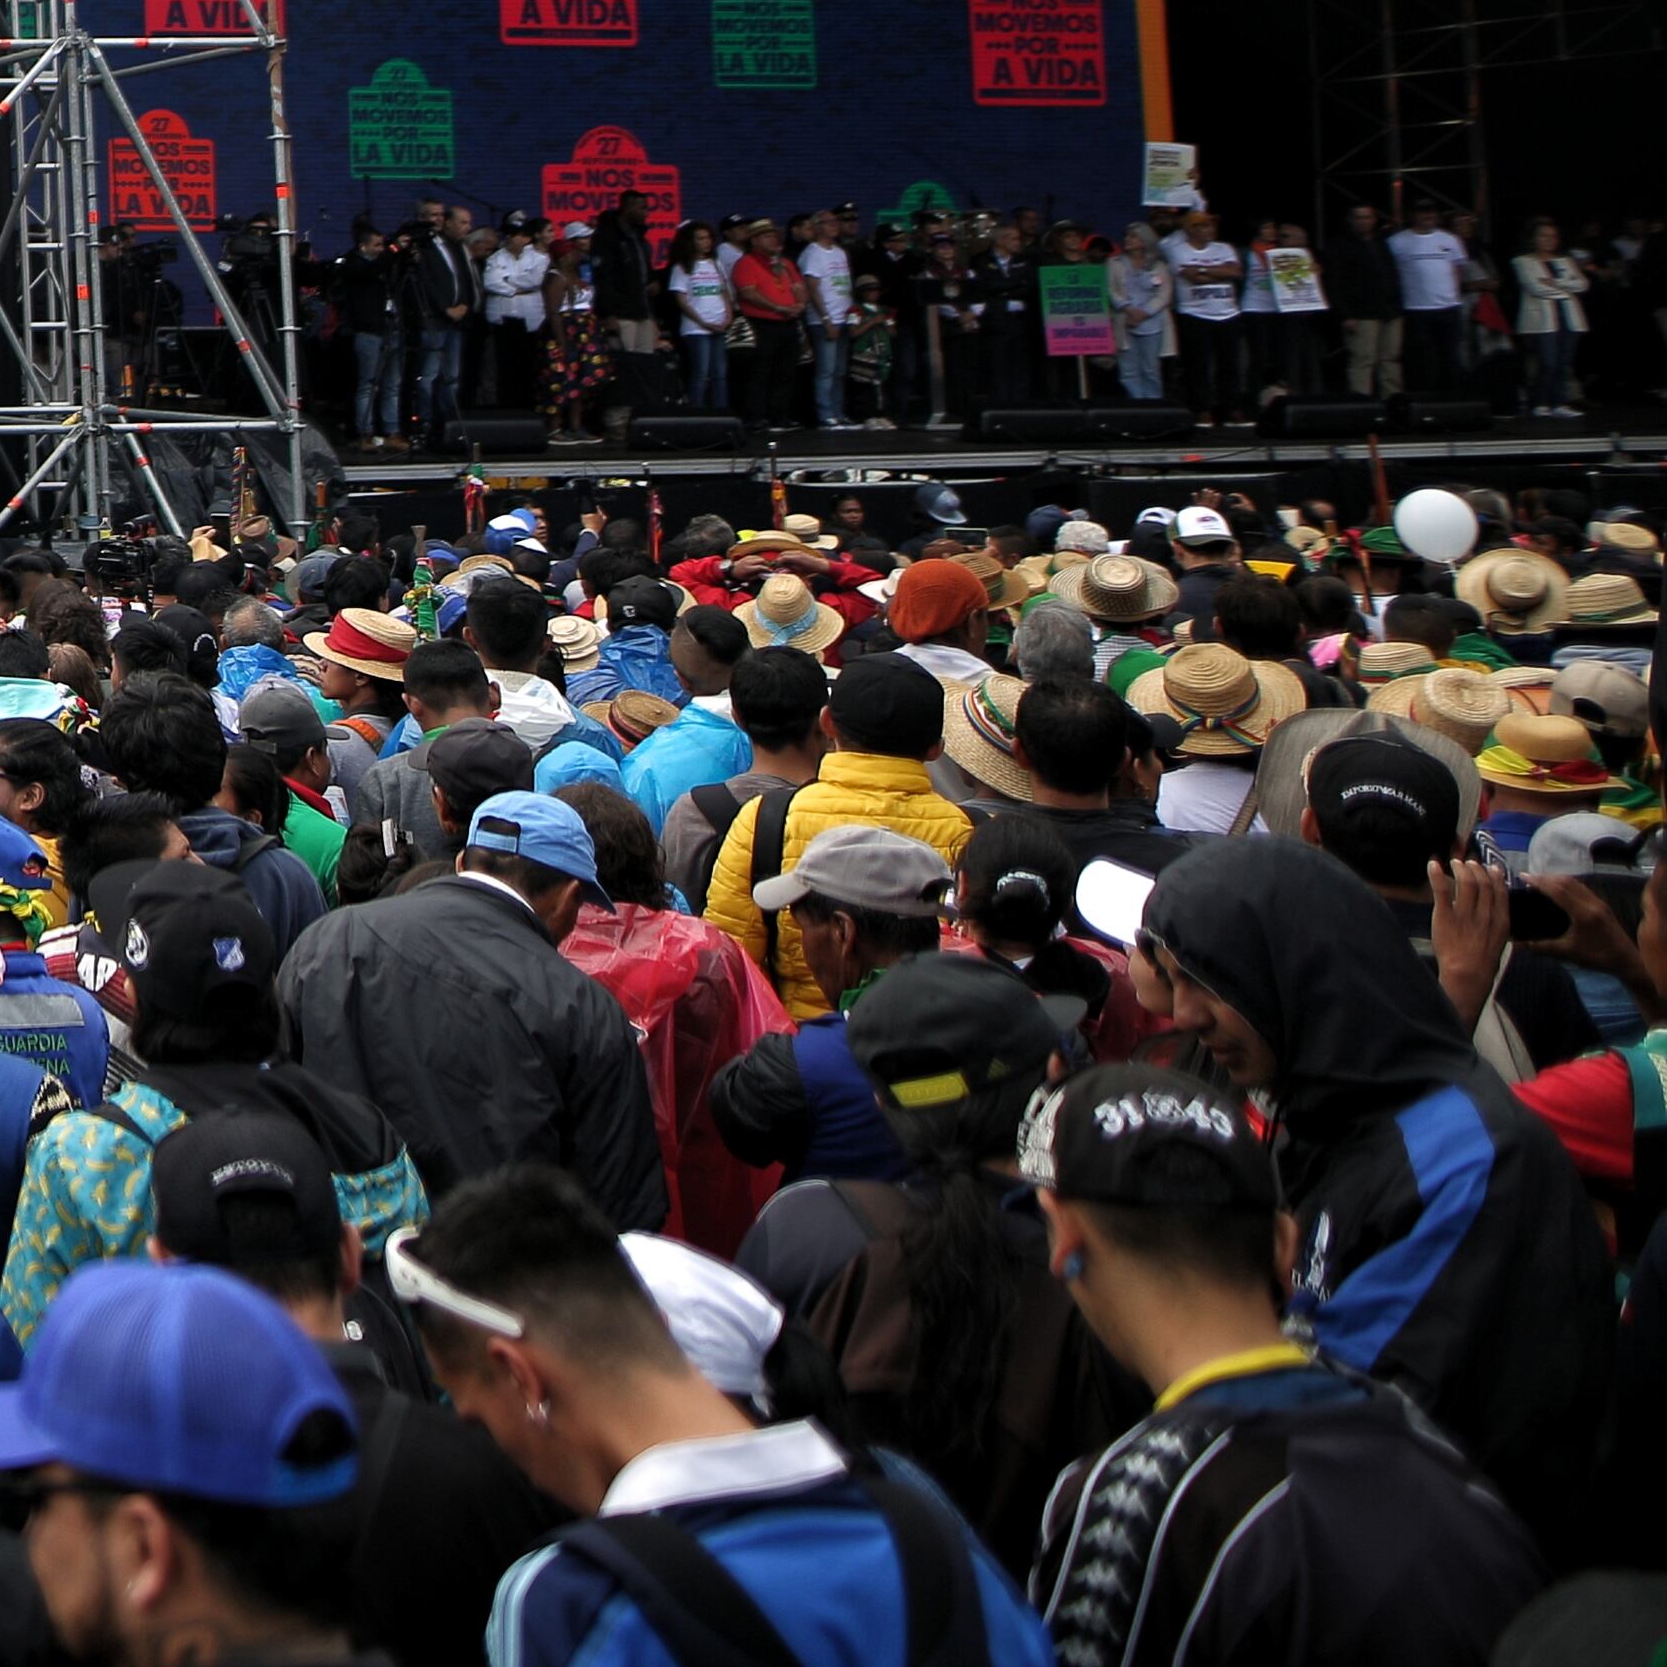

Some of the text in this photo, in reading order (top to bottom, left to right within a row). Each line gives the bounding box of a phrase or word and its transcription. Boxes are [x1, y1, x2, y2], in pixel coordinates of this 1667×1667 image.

[974, 14, 1097, 33] MOVEMOS
[1014, 36, 1060, 54] POR
[1024, 58, 1100, 86] VIDA
[390, 142, 450, 165] VIDA
[116, 159, 211, 174] MOEMOS
[142, 176, 179, 191] PR
[586, 169, 635, 188] NOS
[150, 193, 212, 216] VDA
[548, 191, 674, 212] MOVEOS
